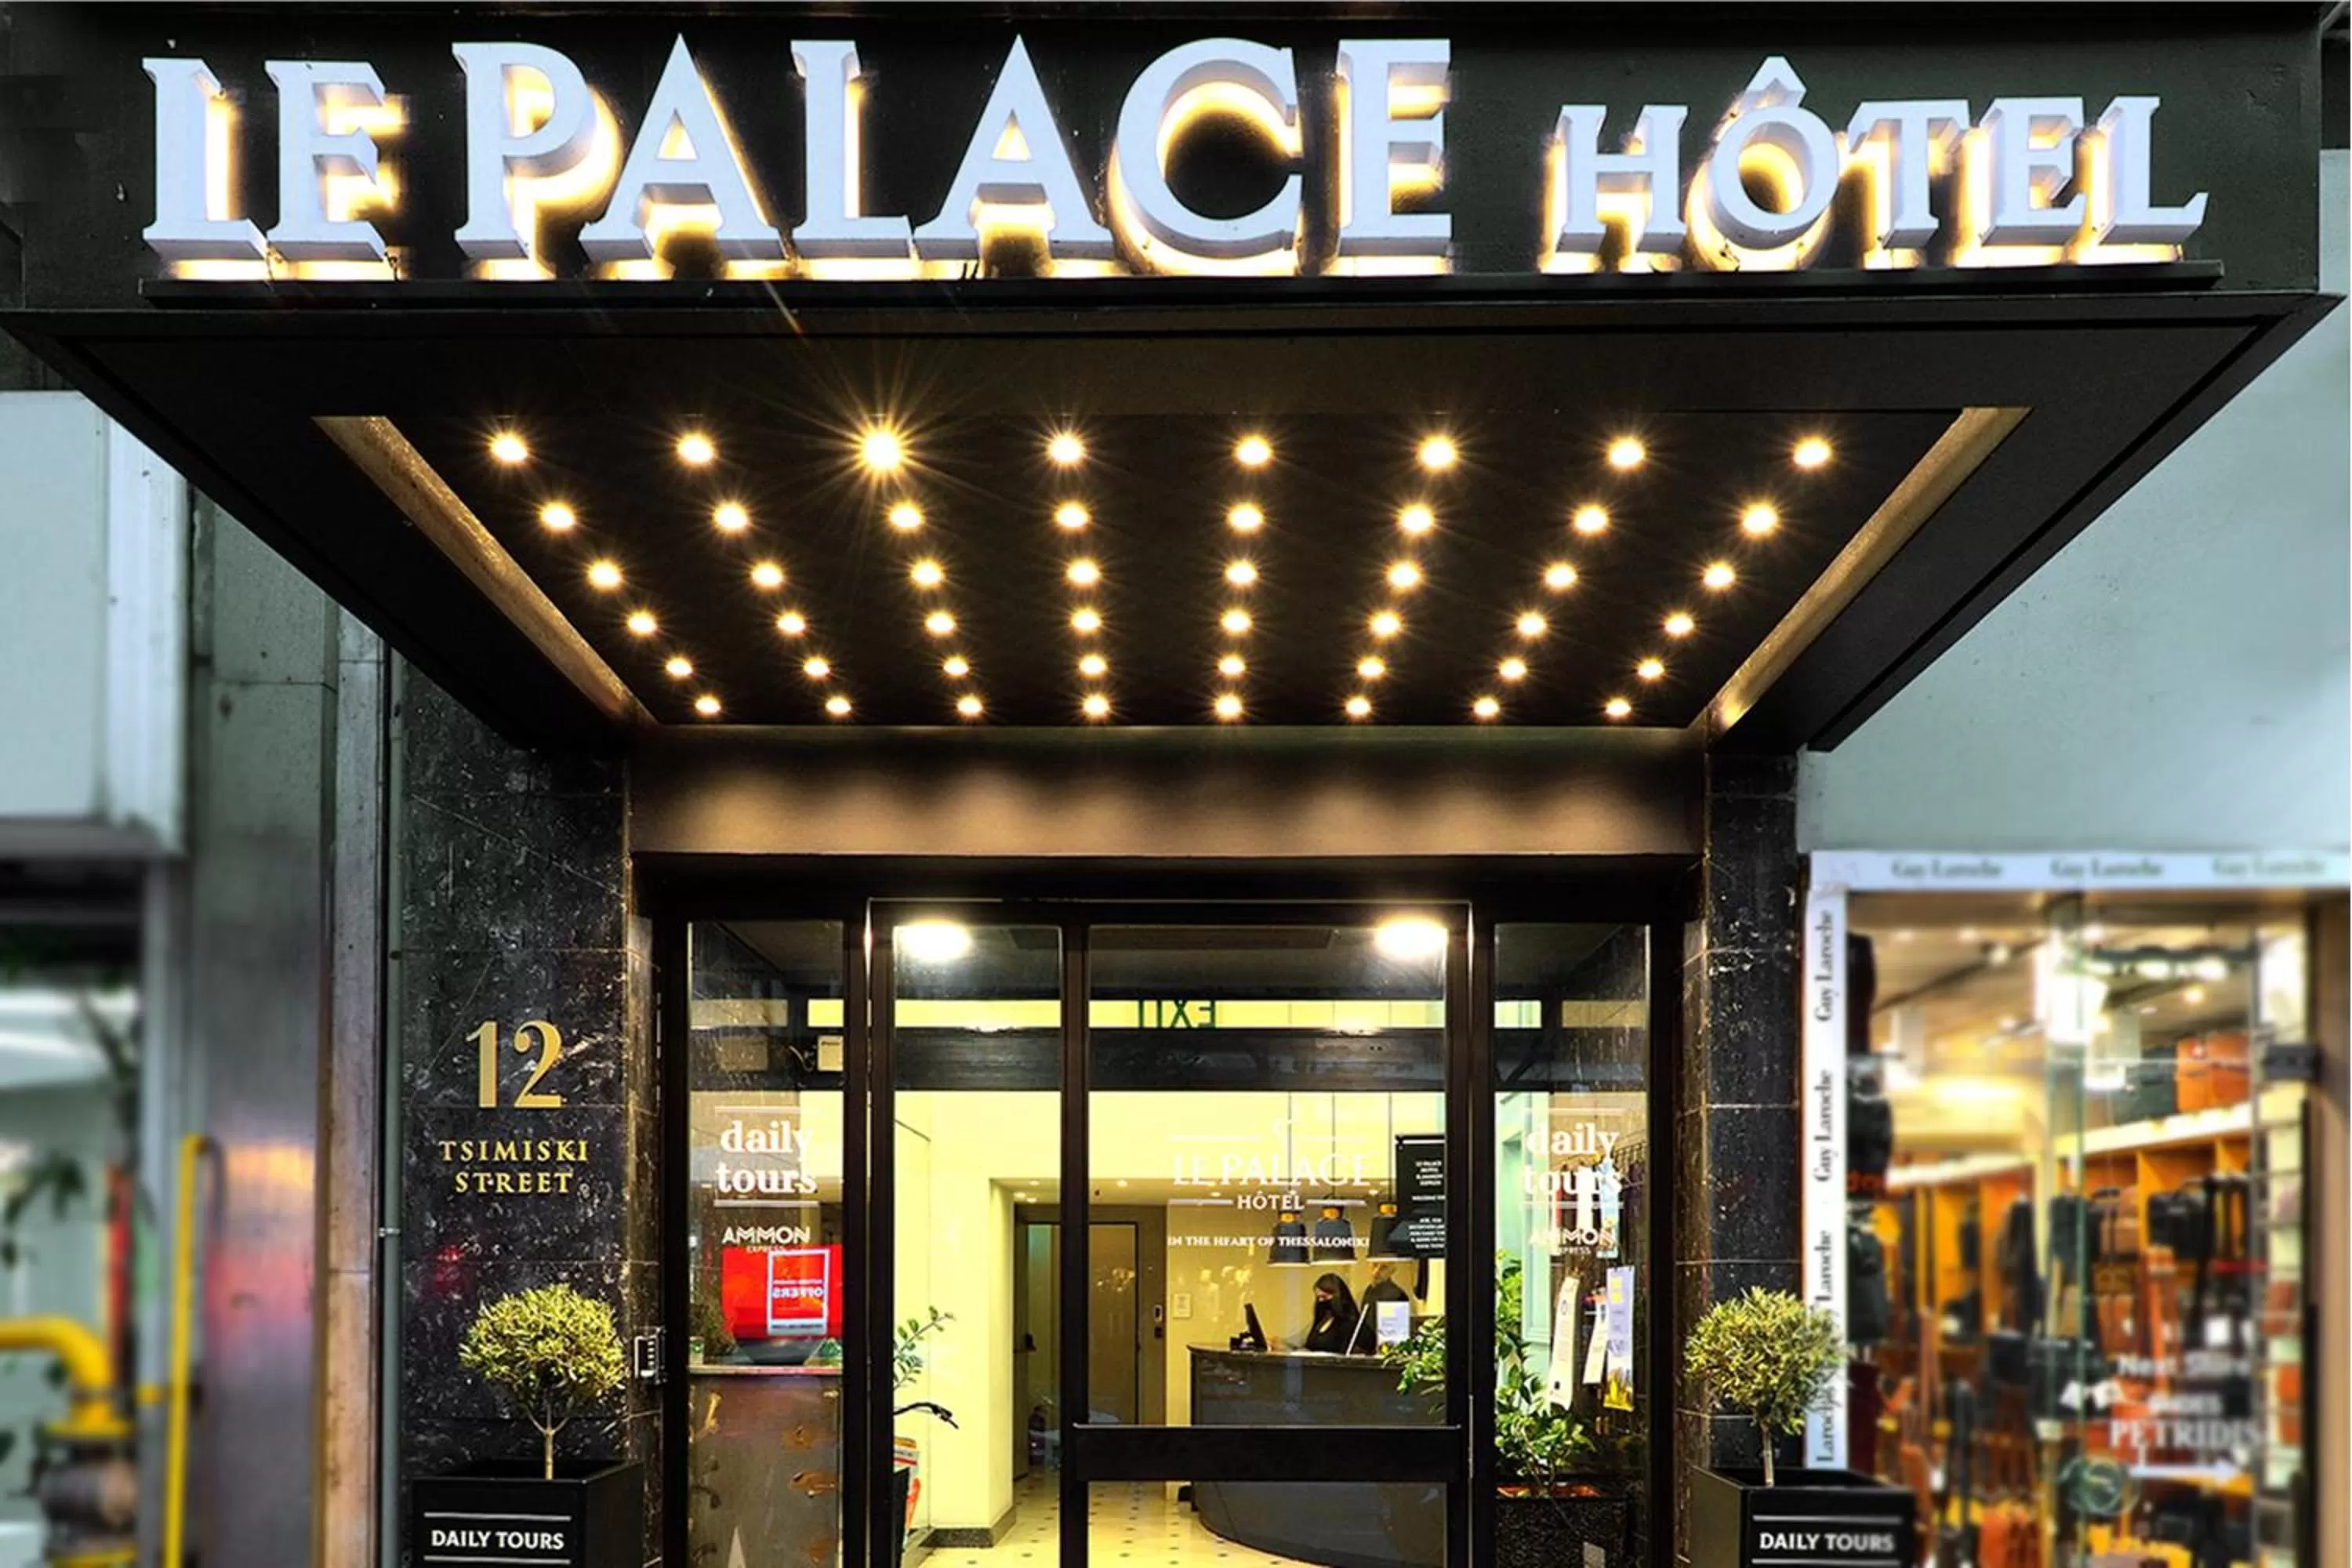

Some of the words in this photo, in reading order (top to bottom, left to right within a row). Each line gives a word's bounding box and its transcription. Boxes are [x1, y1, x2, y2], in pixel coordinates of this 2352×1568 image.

[142, 56, 392, 259] LE
[452, 33, 1451, 260] PALACE
[1555, 56, 2209, 251] HÔTEL
[1814, 909, 1833, 982] Laroche
[466, 1020, 562, 1108] 12
[1813, 1069, 1832, 1142] Laroche
[438, 1140, 588, 1162] TSIMISKI
[720, 1120, 813, 1163] daily
[1526, 1122, 1619, 1164] daily
[456, 1171, 574, 1193] STREET
[714, 1162, 818, 1194] tours
[1173, 1152, 1215, 1186] LE
[1220, 1152, 1370, 1186] PALACE
[721, 1225, 811, 1245] AMMON
[1185, 1236, 1210, 1247] THE
[1214, 1236, 1254, 1247] HEART
[1258, 1236, 1276, 1247] OF
[1529, 1226, 1617, 1247] AMON
[431, 1530, 492, 1548] DAILY
[495, 1531, 564, 1550] TOURS
[1759, 1532, 1820, 1550] DAILY
[1824, 1534, 1895, 1552] TOURS
